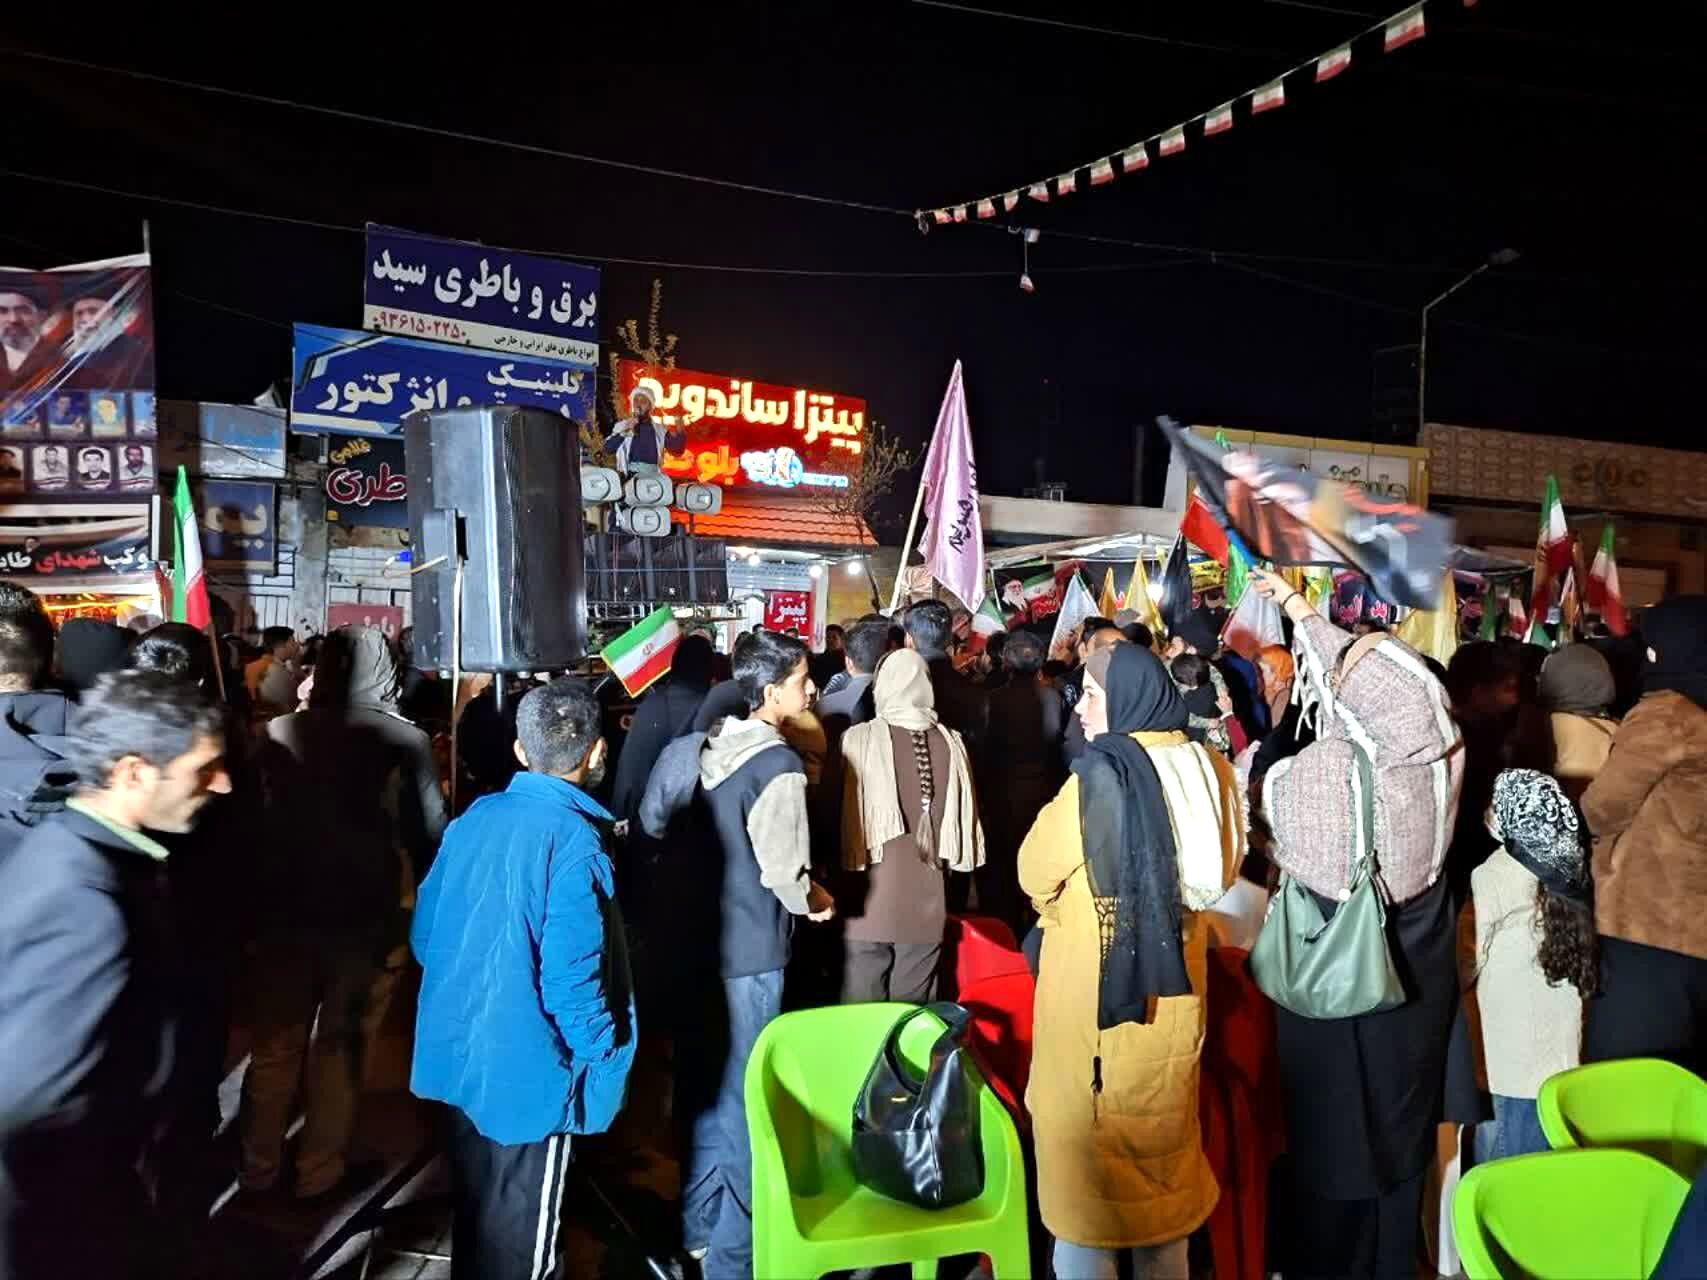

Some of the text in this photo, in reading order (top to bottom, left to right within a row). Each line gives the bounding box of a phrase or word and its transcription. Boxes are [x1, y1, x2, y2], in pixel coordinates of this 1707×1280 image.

[372, 249, 597, 328] برق و باطری سید
[494, 335, 519, 346] خارجی
[524, 339, 544, 351] ایرانی
[544, 342, 557, 353] های
[558, 345, 577, 356] باطری
[578, 348, 594, 360] انواع
[487, 363, 580, 398] کلینیک
[316, 373, 448, 418] انژکتور
[793, 390, 863, 454] پیتزا
[326, 462, 408, 507] طری
[35, 549, 101, 574] شهدای
[104, 546, 150, 570] وکب
